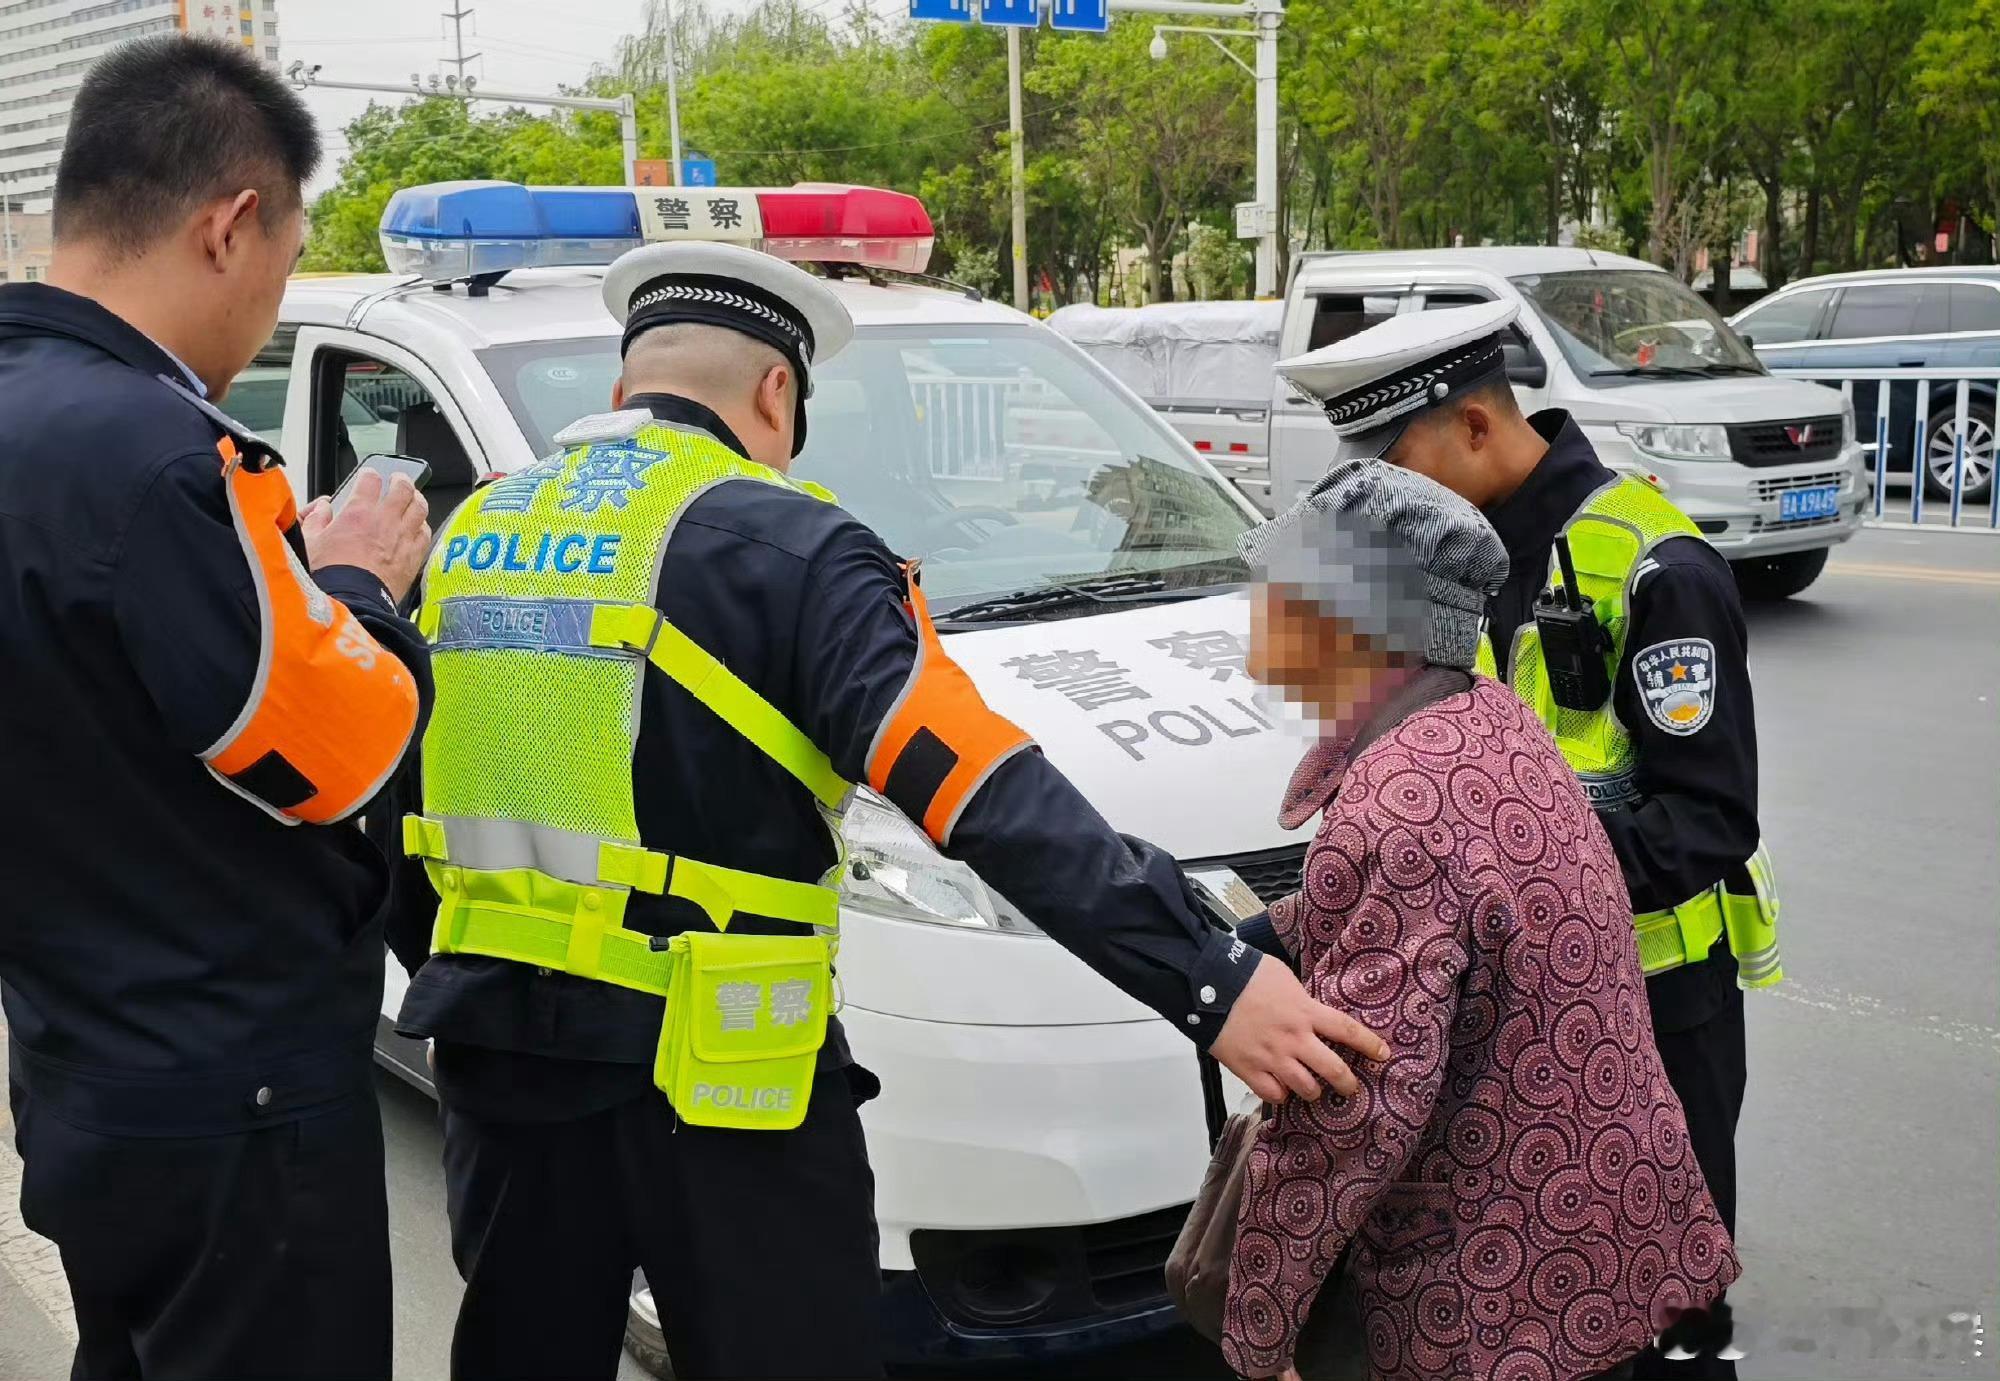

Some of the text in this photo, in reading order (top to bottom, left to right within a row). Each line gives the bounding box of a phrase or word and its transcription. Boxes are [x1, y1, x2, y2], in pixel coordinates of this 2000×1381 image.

[654, 197, 743, 231] 警察
[443, 532, 622, 575] POLICE
[480, 607, 545, 635] POLICE
[1000, 630, 1251, 712] 警察
[1639, 645, 1709, 672] 中华人民共和国
[1096, 697, 1275, 762] POLI
[716, 977, 813, 1032] 警察
[692, 1083, 794, 1111] POLICE
